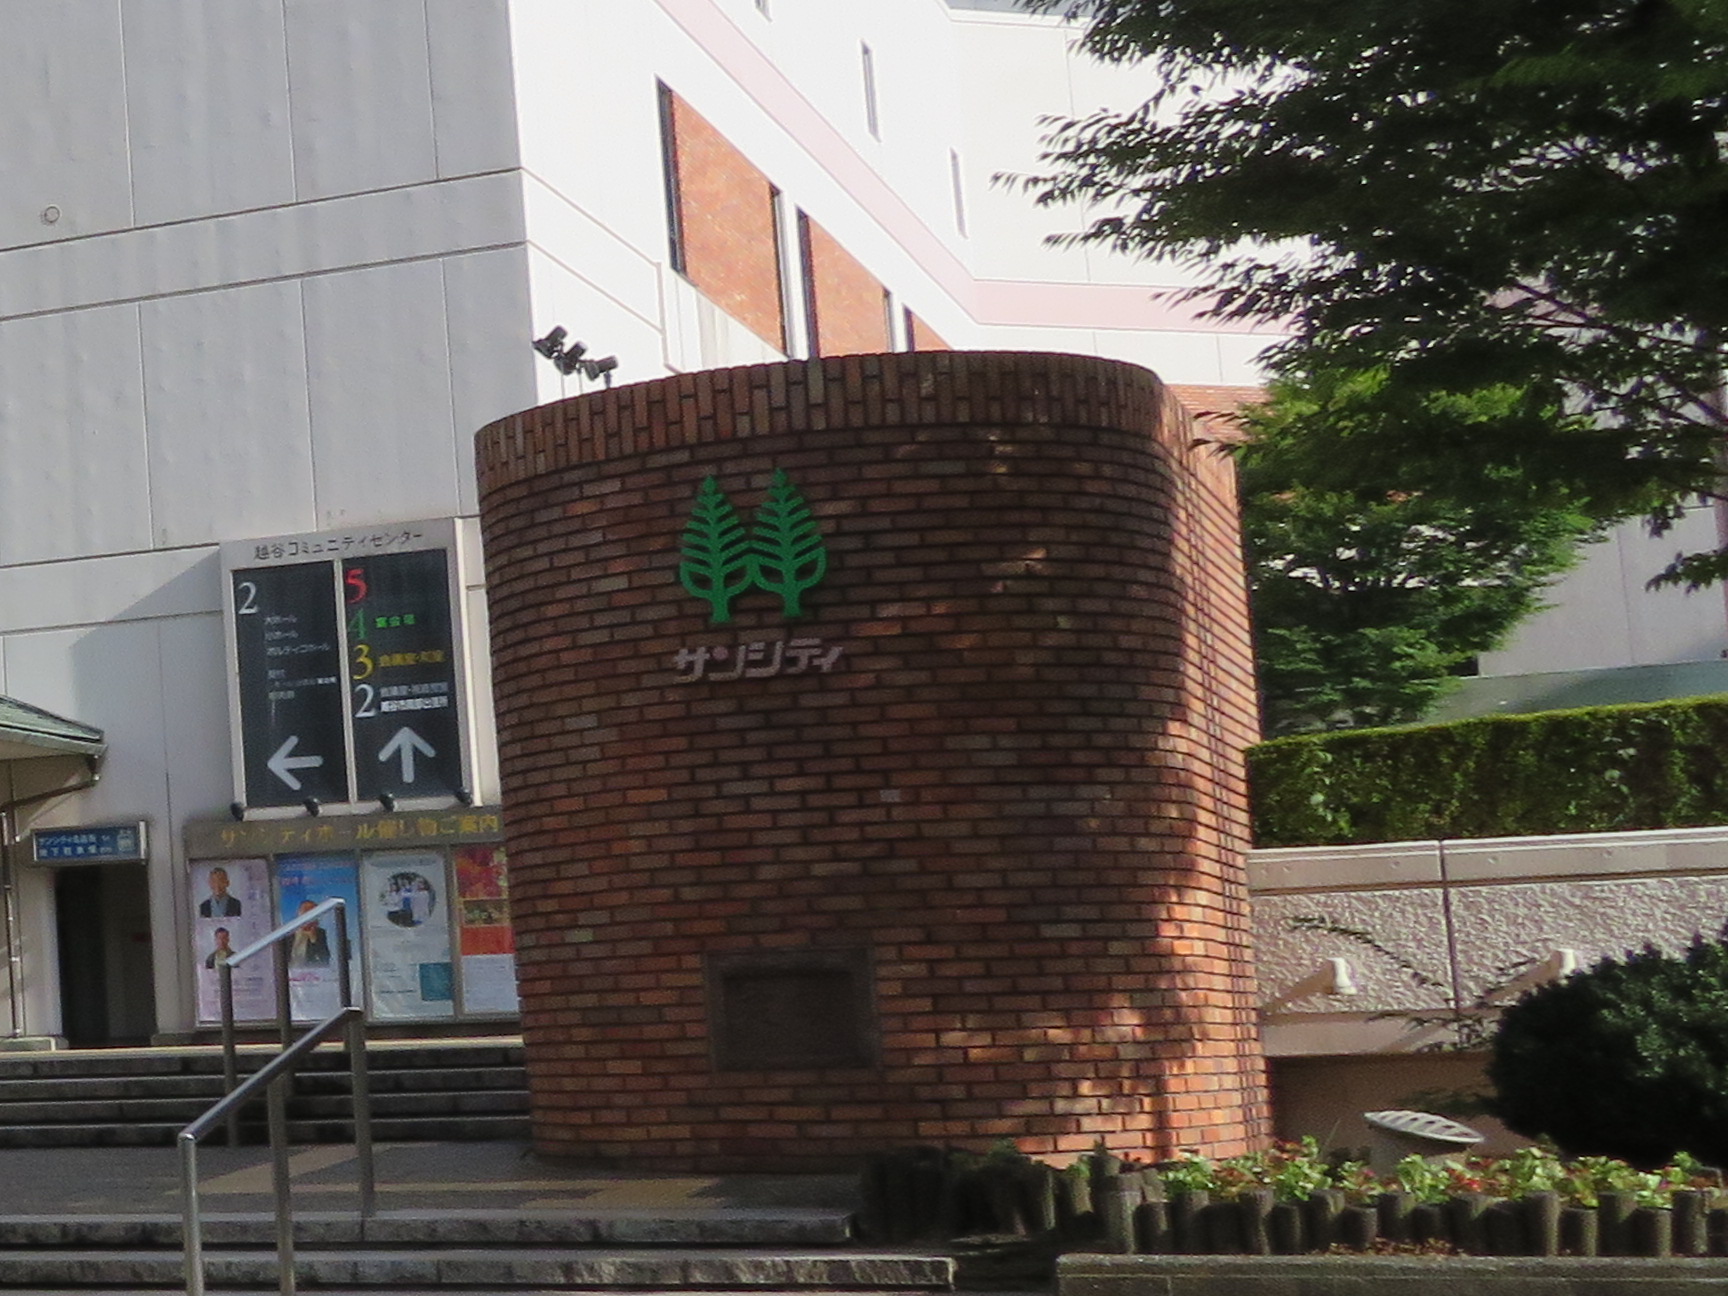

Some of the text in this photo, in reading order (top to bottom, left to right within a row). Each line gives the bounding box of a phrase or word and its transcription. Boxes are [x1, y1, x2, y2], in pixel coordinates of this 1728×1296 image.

[254, 530, 423, 561] 越谷コミュニティセンター
[237, 581, 259, 615] 2
[345, 568, 369, 604] 5
[347, 608, 368, 640] 4
[352, 644, 374, 680] 3
[673, 637, 844, 684] サンシティ
[354, 683, 376, 718] 2
